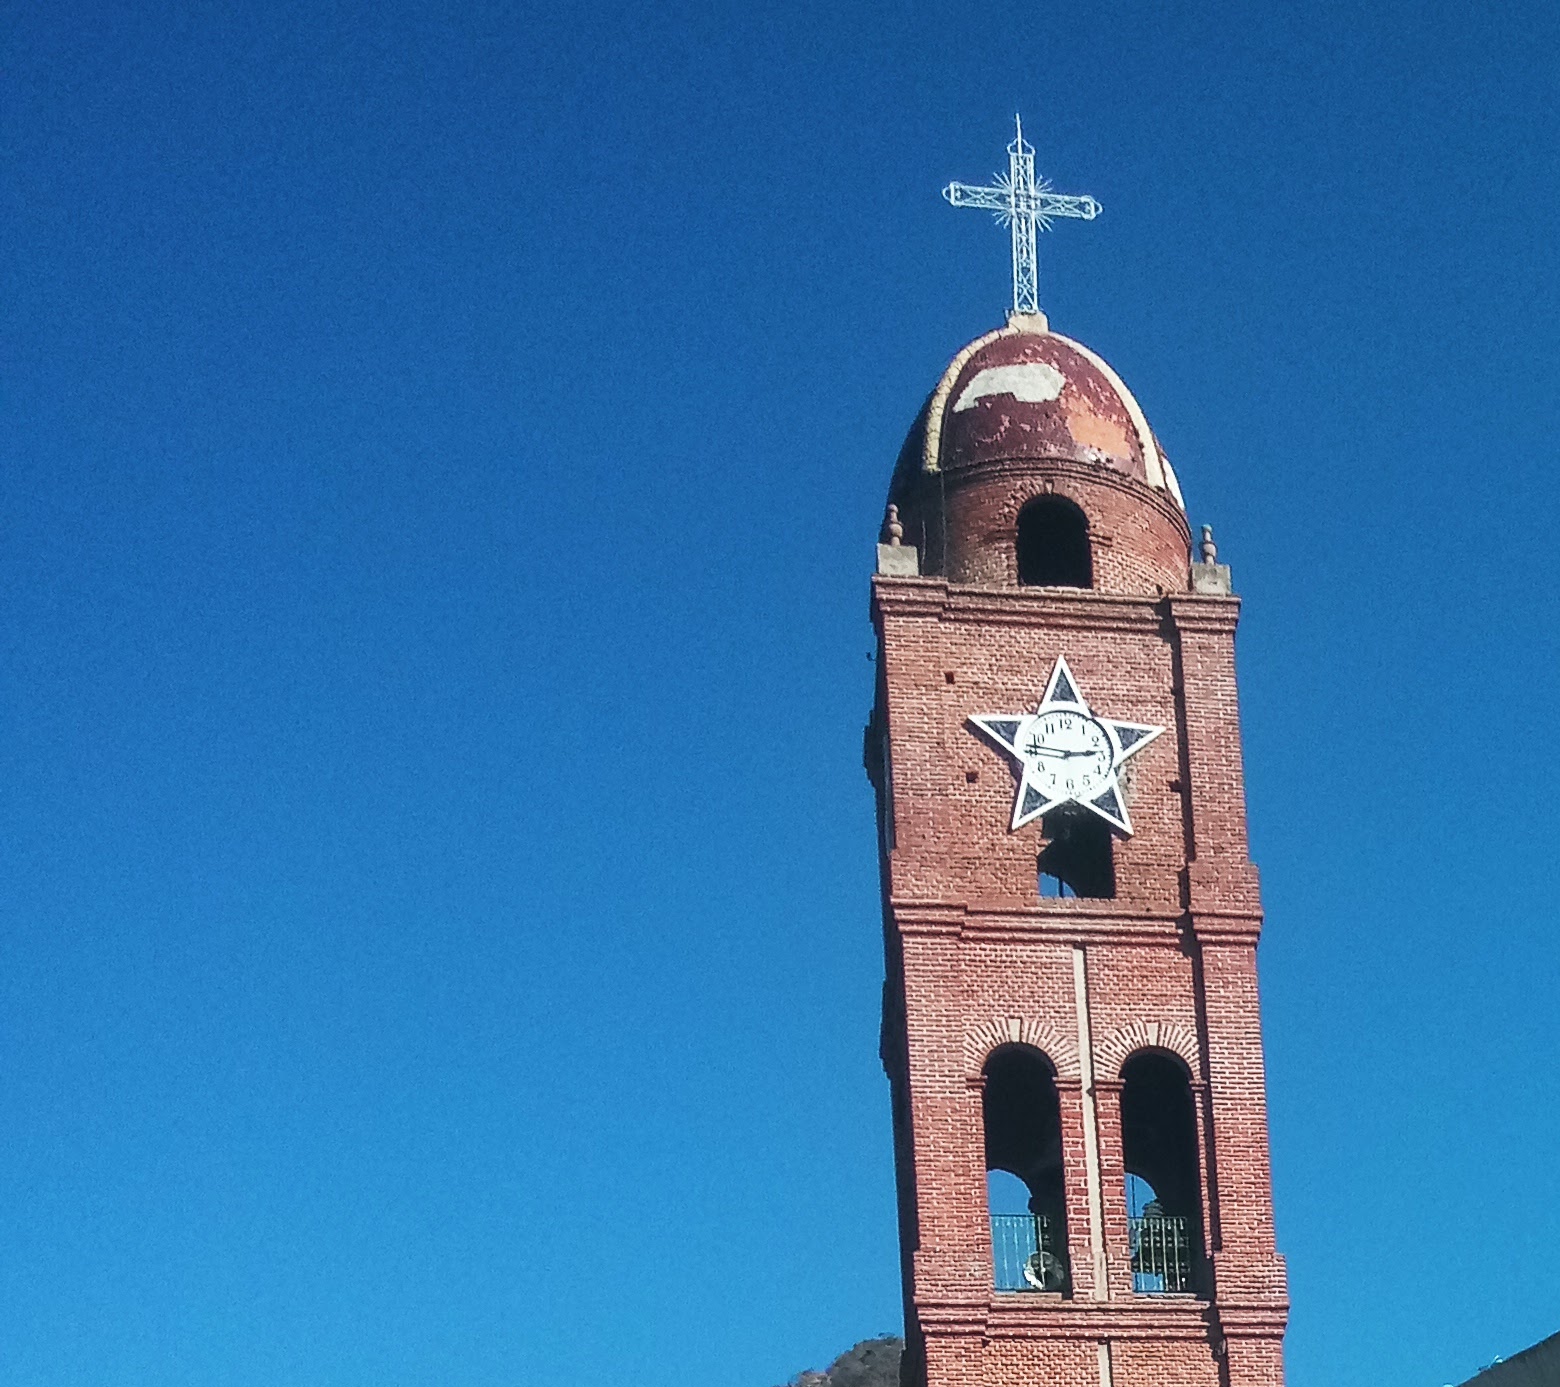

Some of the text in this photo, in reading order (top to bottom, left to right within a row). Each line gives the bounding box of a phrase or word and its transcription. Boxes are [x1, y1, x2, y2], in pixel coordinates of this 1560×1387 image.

[1046, 723, 1054, 734] 11
[1060, 719, 1072, 729] 12
[1081, 725, 1086, 735] 1
[1033, 734, 1044, 745] 10
[1091, 736, 1099, 747] 2
[1038, 761, 1045, 772] 8
[1093, 765, 1101, 775] 4
[1050, 774, 1056, 784] 7
[1066, 778, 1074, 790] 6
[1083, 775, 1090, 786] 5
